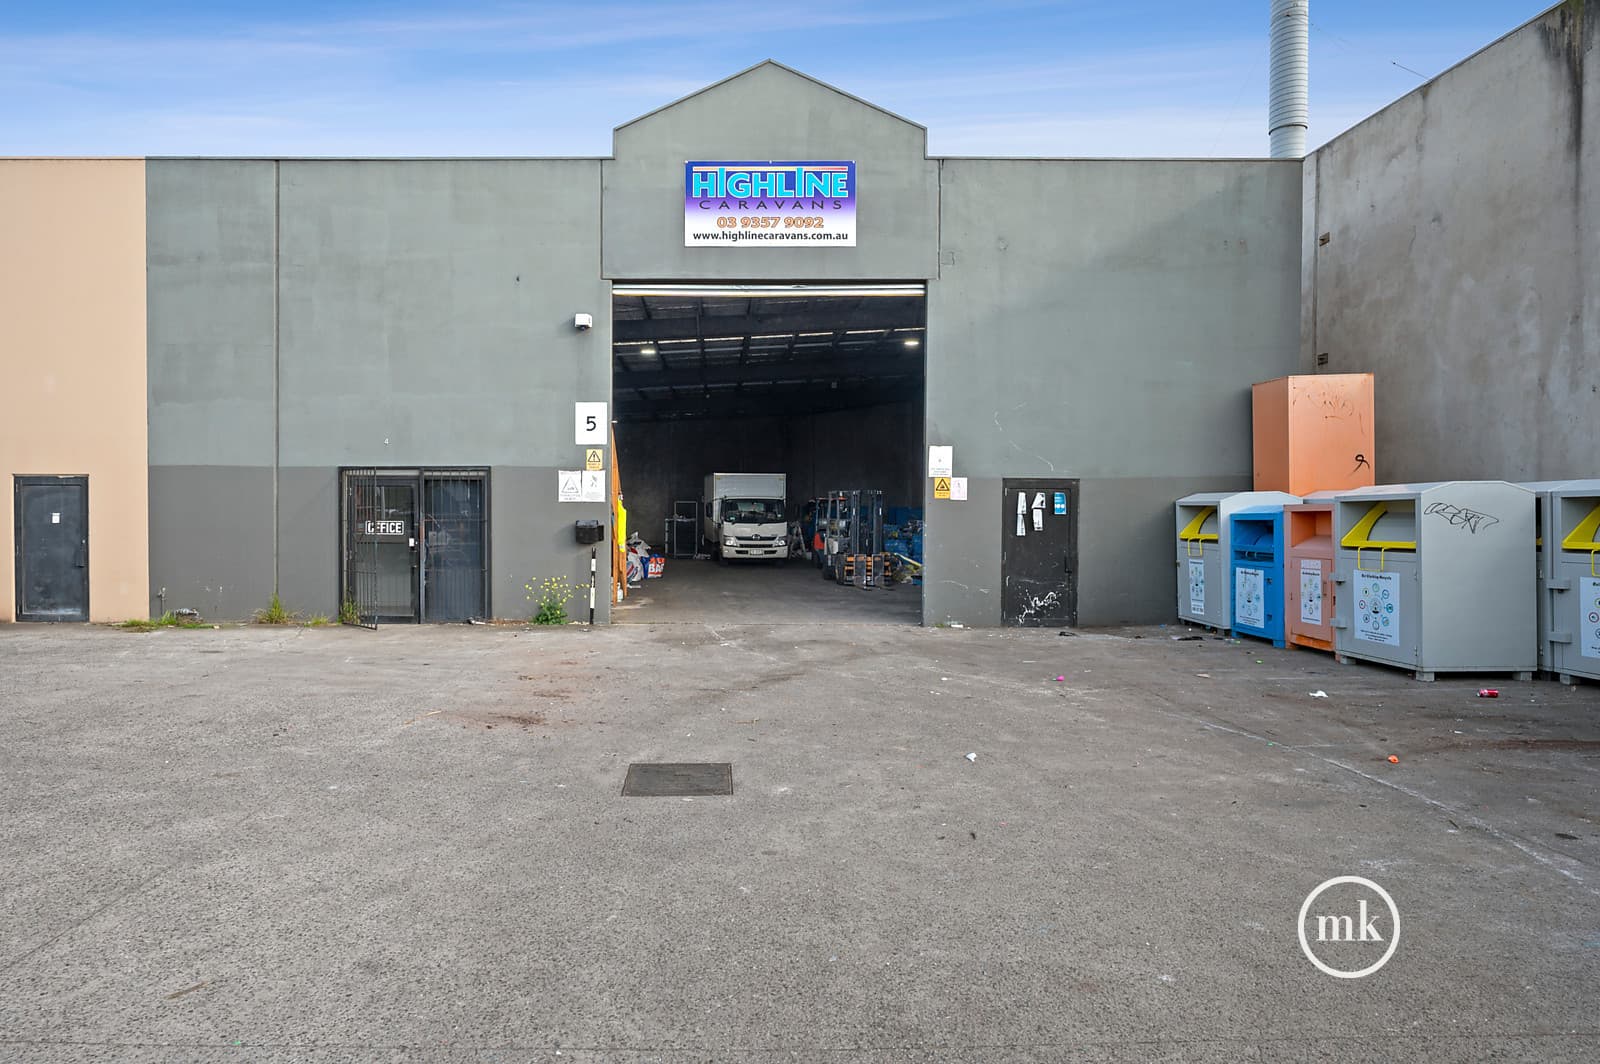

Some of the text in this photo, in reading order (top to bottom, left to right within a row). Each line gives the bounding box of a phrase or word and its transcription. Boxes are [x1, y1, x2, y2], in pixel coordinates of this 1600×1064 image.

[692, 167, 849, 198] HIGHLINE
[699, 200, 842, 210] CARAVANS
[716, 216, 825, 229] 03 9357 9092
[693, 231, 849, 242] www.highlinecaravans.com.au
[586, 415, 597, 432] 5
